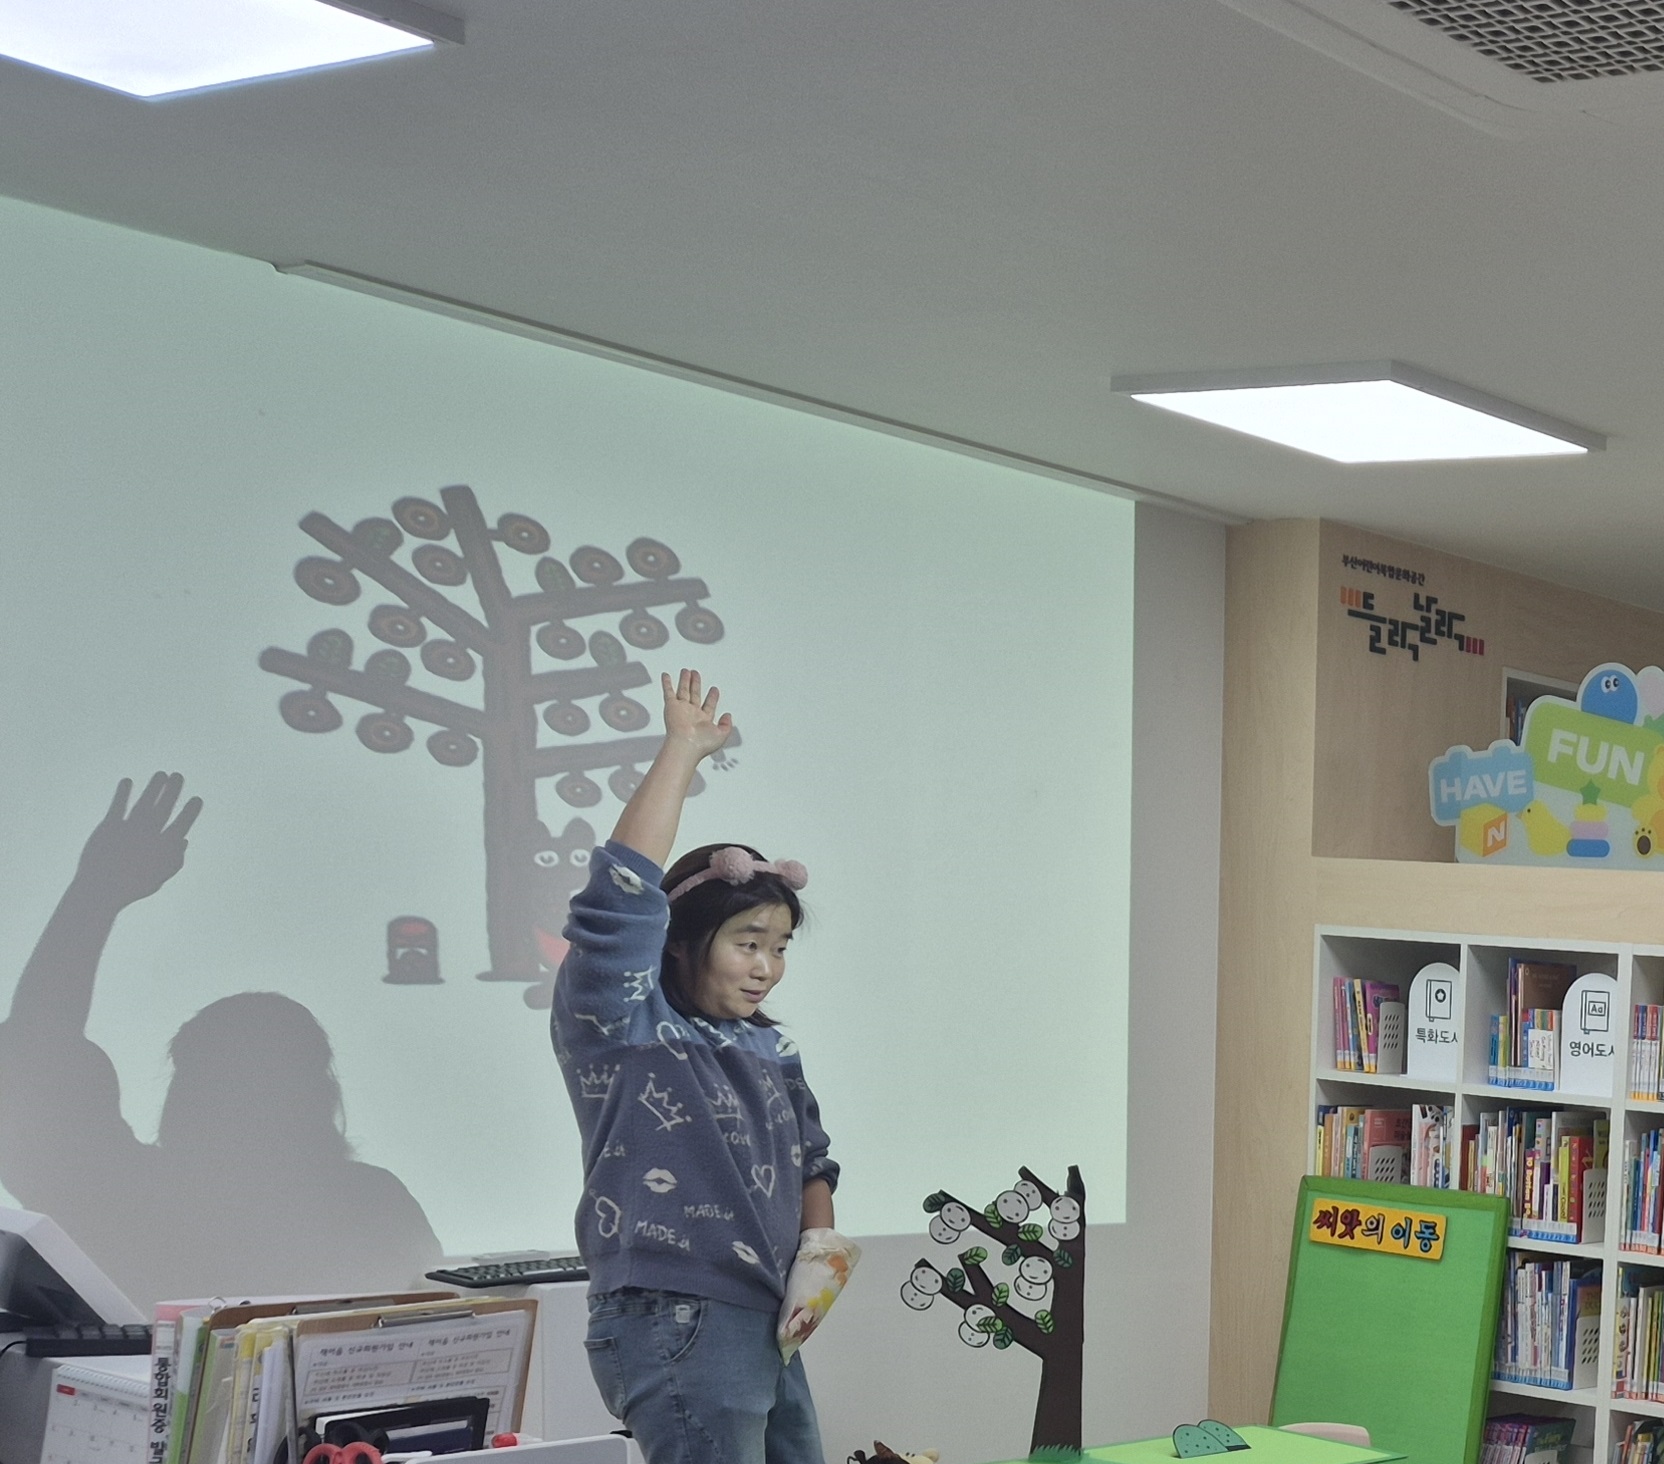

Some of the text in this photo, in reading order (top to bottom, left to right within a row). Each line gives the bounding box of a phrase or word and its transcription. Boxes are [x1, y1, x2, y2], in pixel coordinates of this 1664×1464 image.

[1547, 728, 1644, 785] FUN
[1440, 769, 1527, 803] HAVE
[684, 1204, 721, 1218] MADE
[1313, 1206, 1440, 1252] 씨앗의 이동
[634, 1220, 676, 1245] MADE
[151, 1357, 170, 1433] 통합회원증
